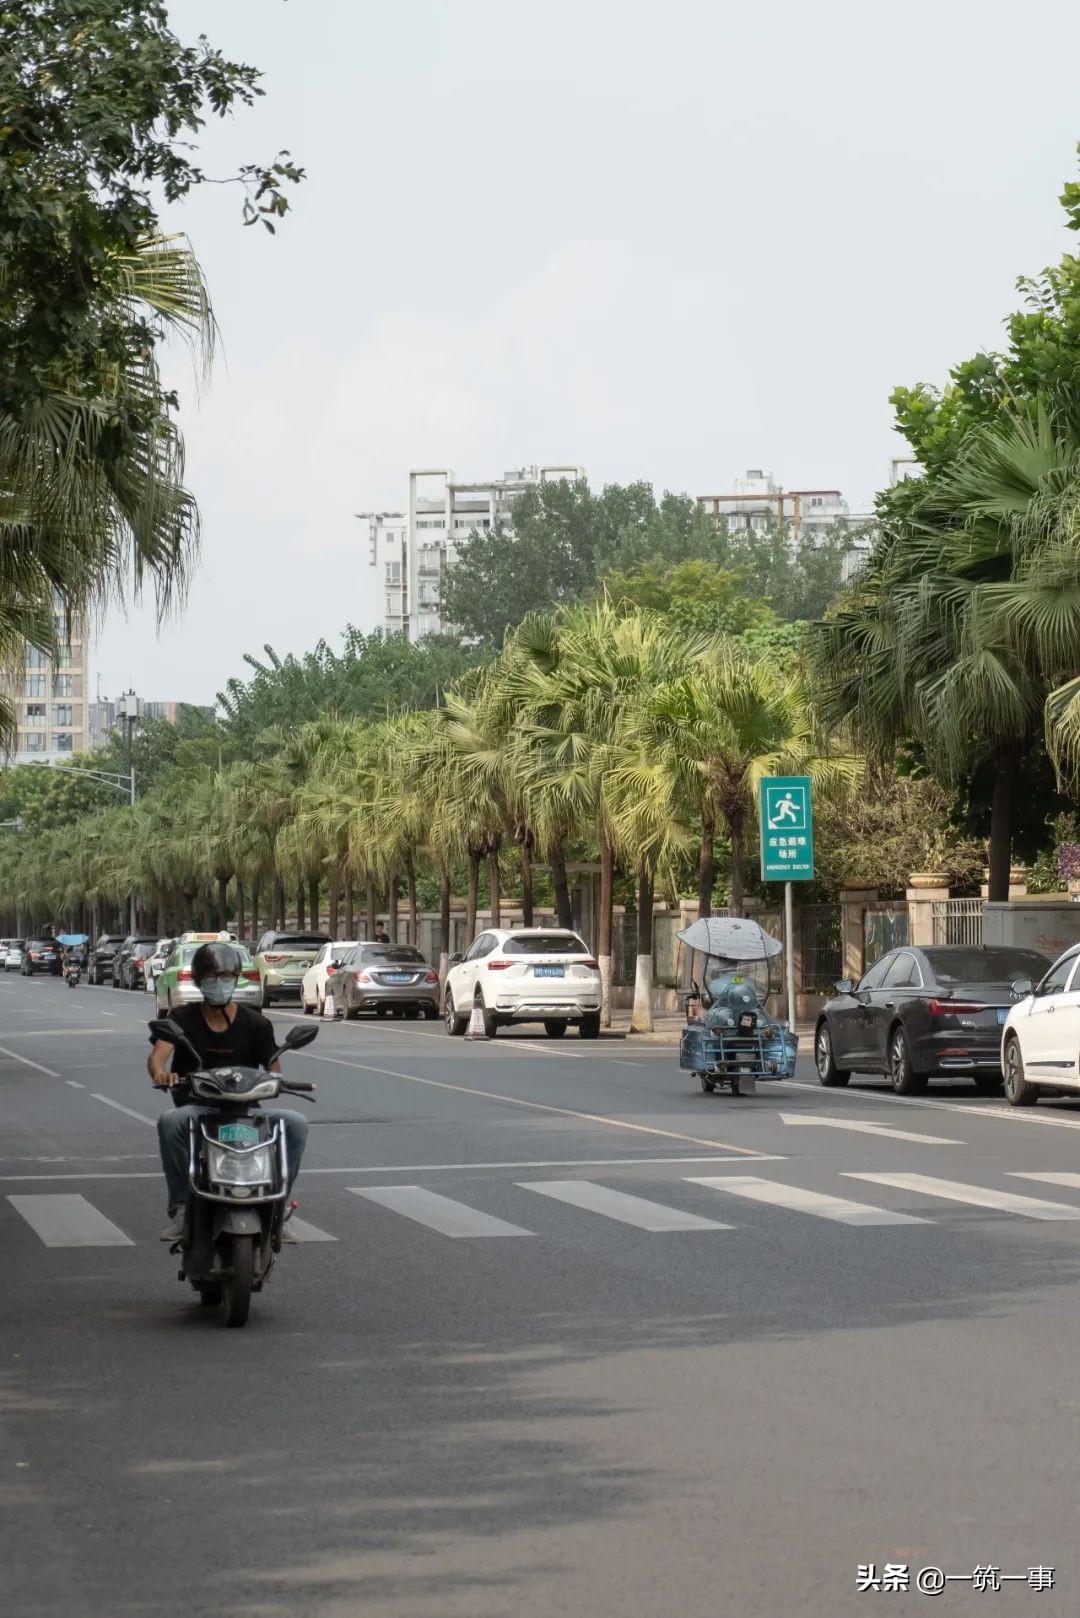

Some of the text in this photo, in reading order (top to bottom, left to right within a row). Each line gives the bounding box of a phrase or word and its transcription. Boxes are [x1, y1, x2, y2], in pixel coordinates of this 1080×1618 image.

[769, 837, 806, 846] 应急避难
[779, 849, 797, 859] 场所
